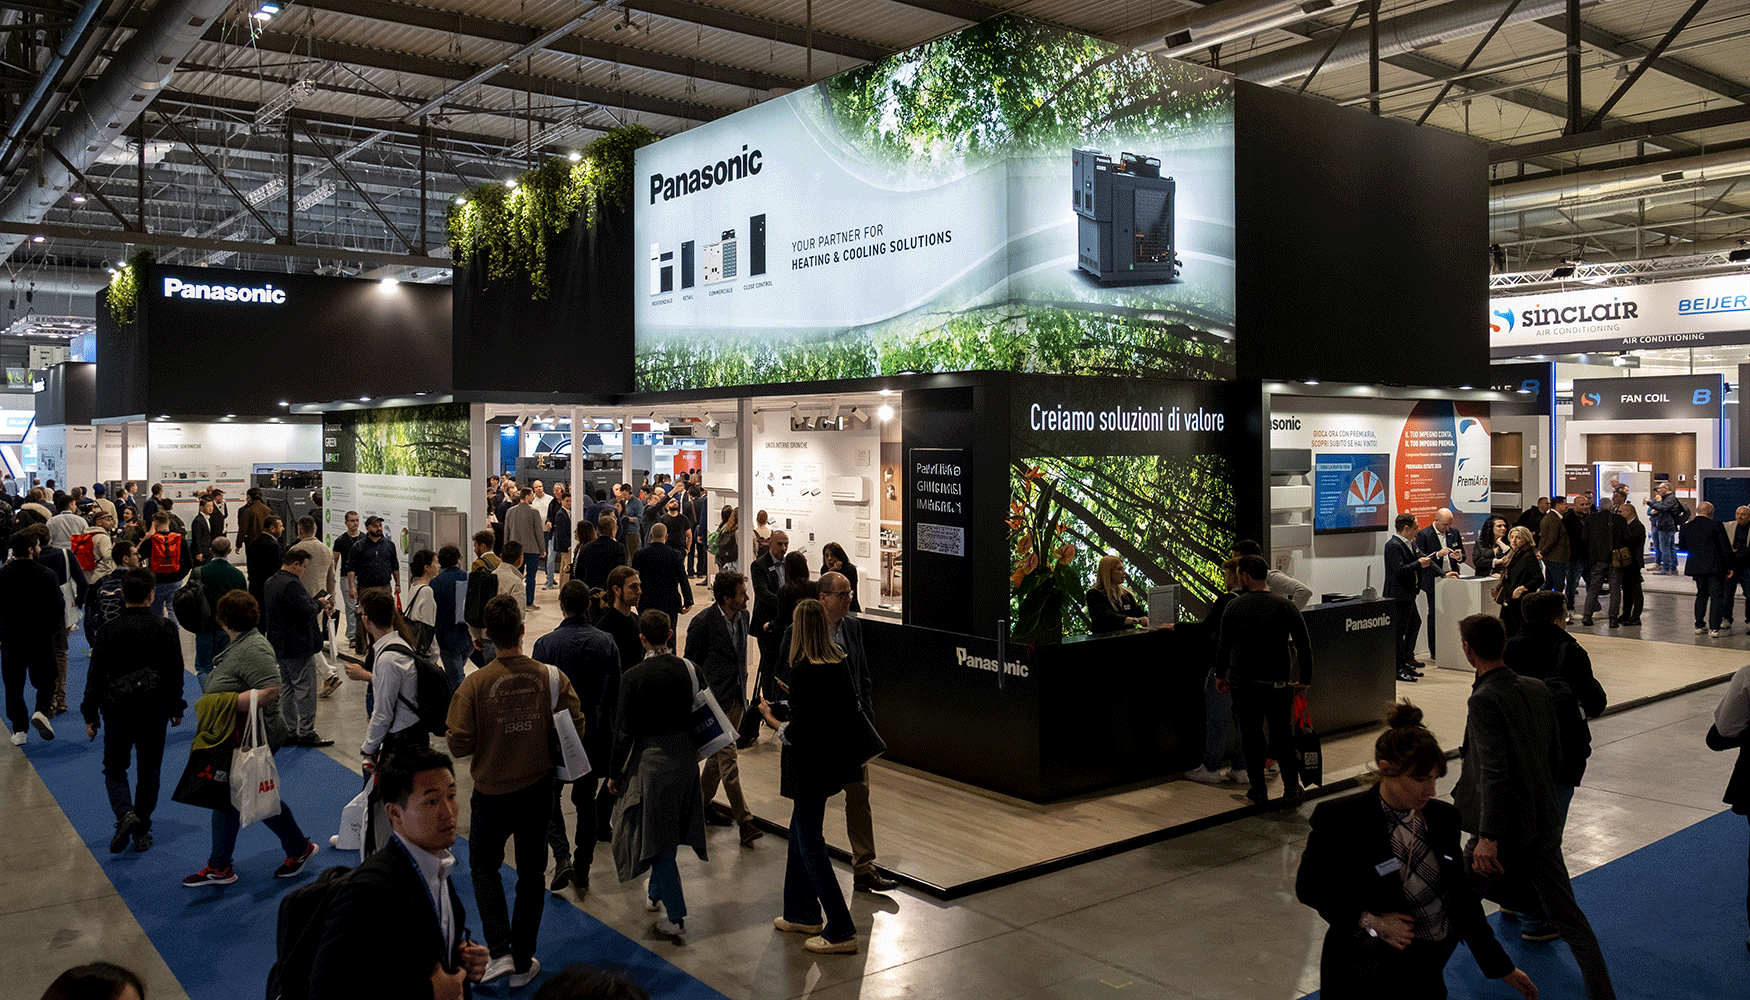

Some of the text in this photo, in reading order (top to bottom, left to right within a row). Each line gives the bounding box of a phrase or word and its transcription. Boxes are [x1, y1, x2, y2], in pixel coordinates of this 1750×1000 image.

[650, 144, 763, 205] Panasonic
[792, 223, 884, 252] YOUR PARTNER FOR
[791, 230, 953, 270] HEATING & COOLING SOLUTIONS
[164, 277, 287, 304] Panasonic
[756, 280, 773, 290] CONTROL
[1678, 295, 1748, 312] BEIJER
[1536, 324, 1620, 337] AIR CONDITIONING
[1622, 332, 1705, 344] AIR CONDITIONING
[1620, 395, 1642, 404] FAN
[1645, 393, 1670, 403] COIL
[1030, 403, 1225, 432] Creiamo soluzioni di valore
[1313, 430, 1328, 438] GIOCA
[1328, 430, 1339, 438] ORA
[1339, 430, 1349, 438] CON
[1456, 475, 1489, 487] PremiAria
[1345, 612, 1391, 632] Panasonic
[504, 720, 533, 735] 1985
[258, 779, 275, 794] ABB
